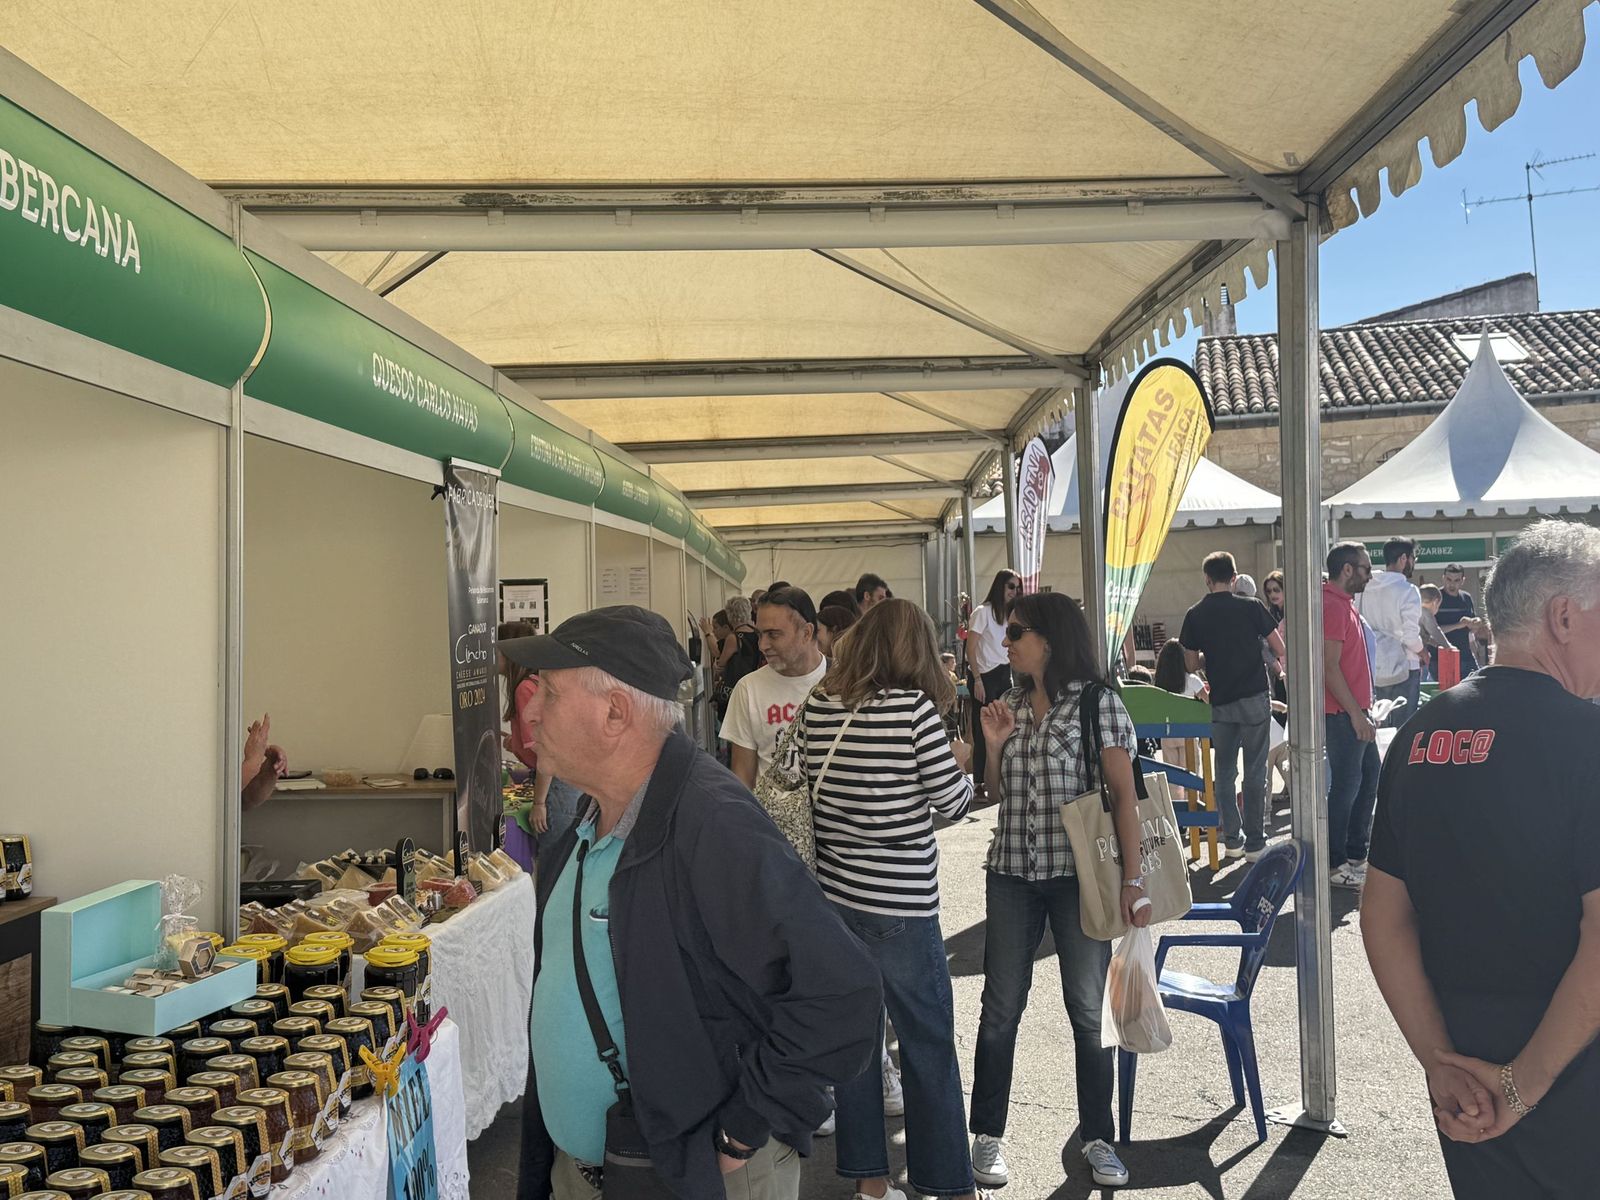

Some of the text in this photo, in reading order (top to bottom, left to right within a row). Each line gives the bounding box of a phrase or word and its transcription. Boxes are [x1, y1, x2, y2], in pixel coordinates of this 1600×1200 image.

[372, 352, 479, 433] QUESOS CARLOS NAVAS
[1110, 388, 1175, 521] PATATAS
[459, 688, 473, 710] ORO
[768, 702, 796, 726] AC
[1408, 729, 1496, 766] LOC@
[1140, 837, 1166, 856] UTURE
[389, 1067, 430, 1157] MIEL
